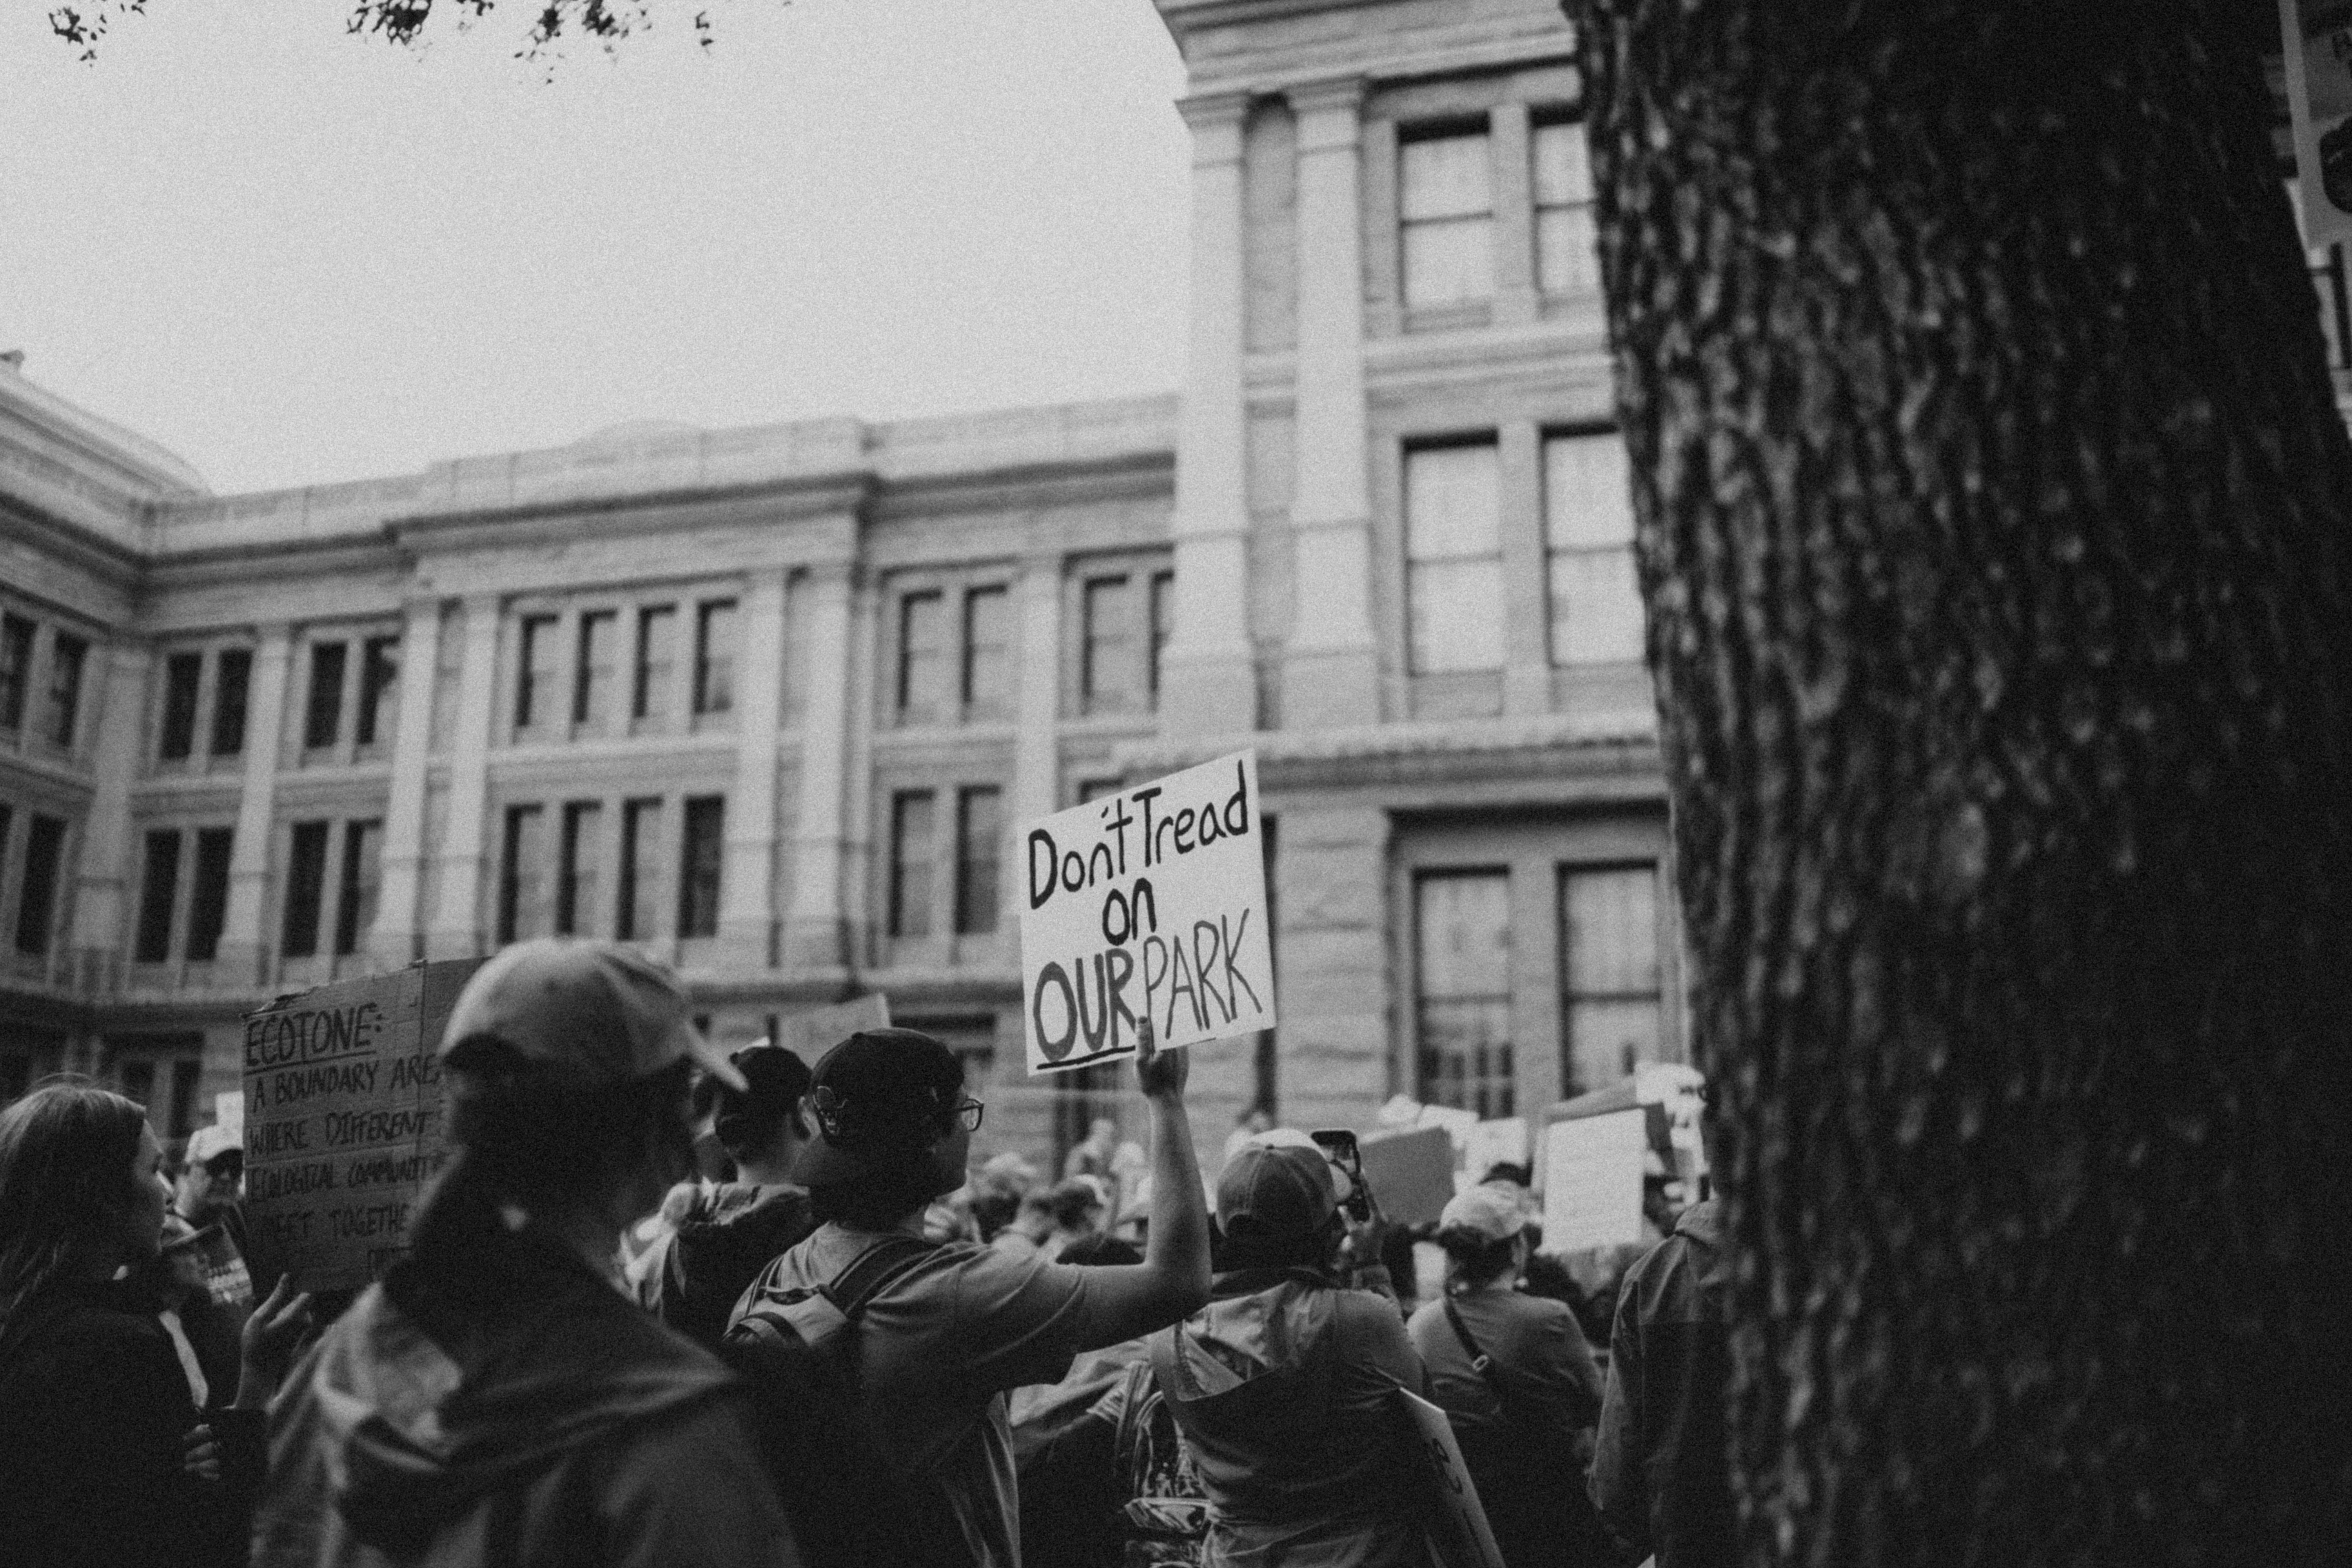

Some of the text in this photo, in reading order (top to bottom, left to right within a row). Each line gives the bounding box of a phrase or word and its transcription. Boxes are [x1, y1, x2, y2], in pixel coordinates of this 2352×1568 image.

[1028, 759, 1249, 910] Don't Tread
[1102, 877, 1157, 946] on
[1033, 907, 1263, 1063] OUR PARK
[246, 1002, 384, 1066] ECOTONE:
[253, 1052, 441, 1113] A BOUNDARY ARE
[250, 1111, 433, 1157] WHERE DIFFERENT
